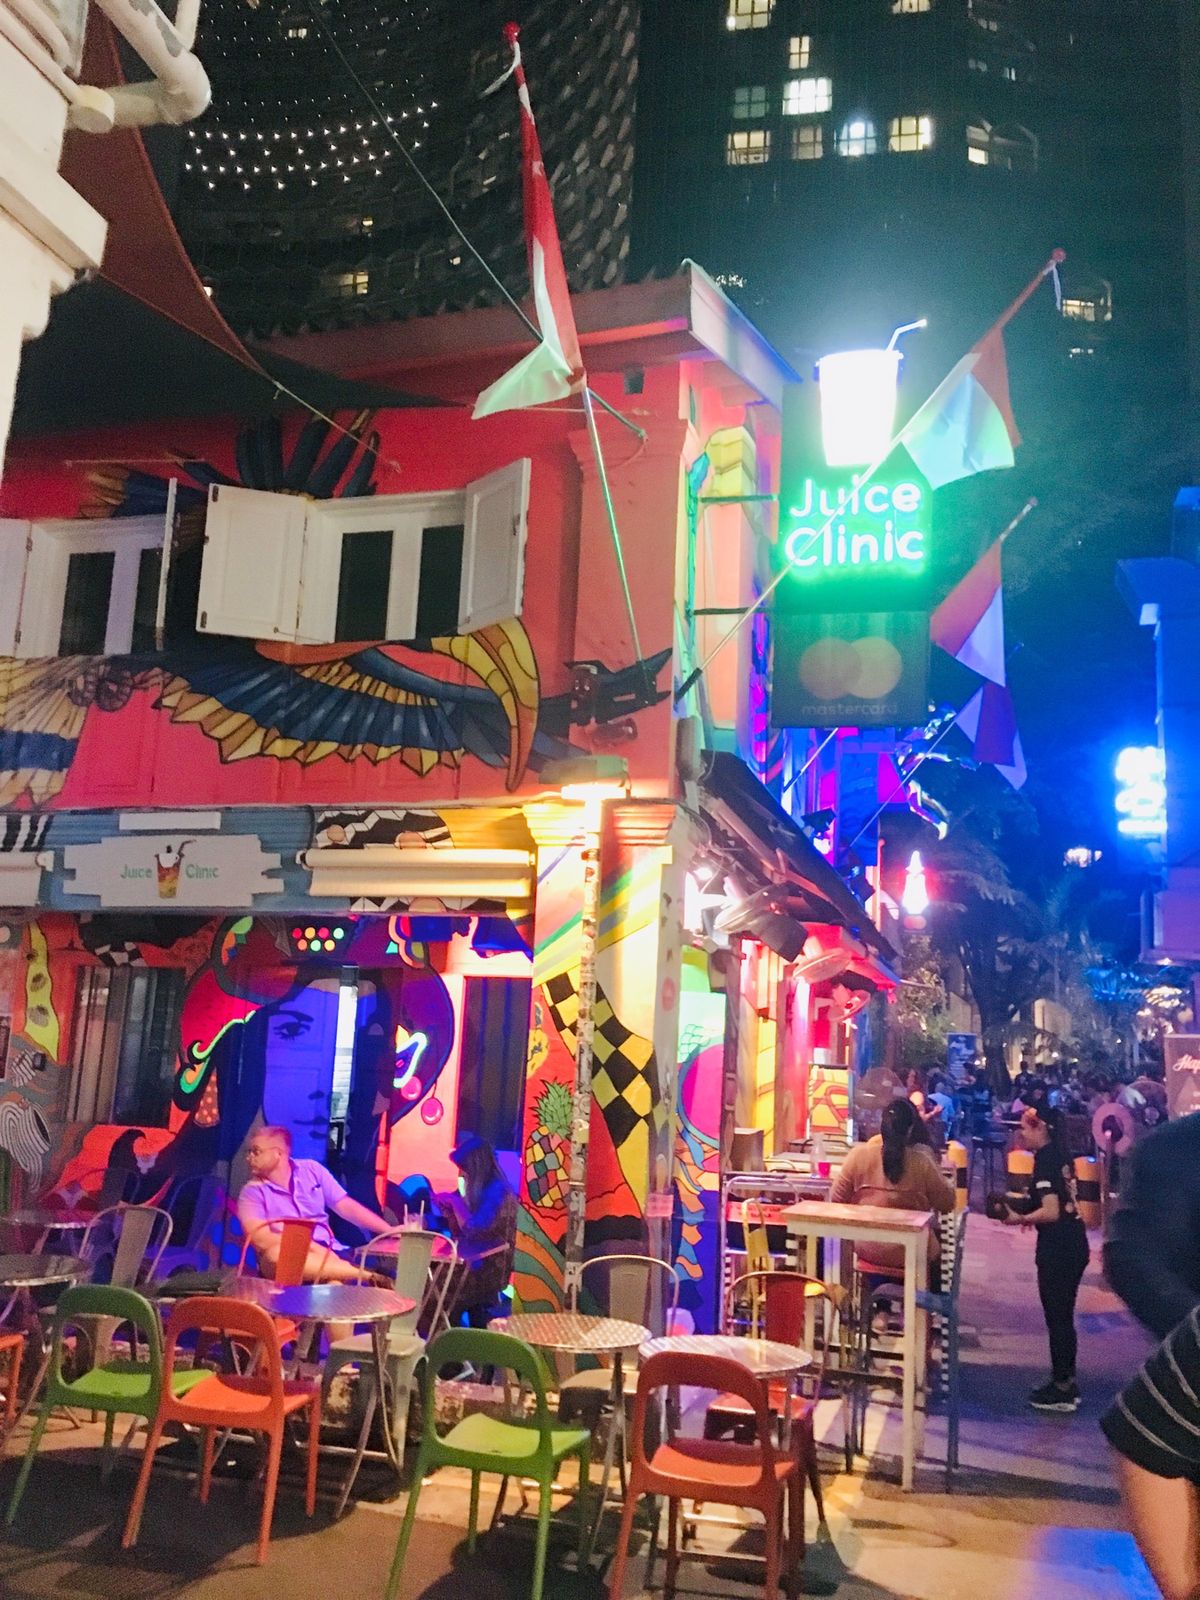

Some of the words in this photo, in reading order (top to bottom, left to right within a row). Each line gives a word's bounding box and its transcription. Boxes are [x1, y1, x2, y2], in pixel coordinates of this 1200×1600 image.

[789, 474, 922, 517] Juice
[785, 519, 924, 567] Clinic
[801, 703, 898, 716] mastercard
[120, 864, 153, 879] Juice
[185, 863, 220, 879] Clinic
